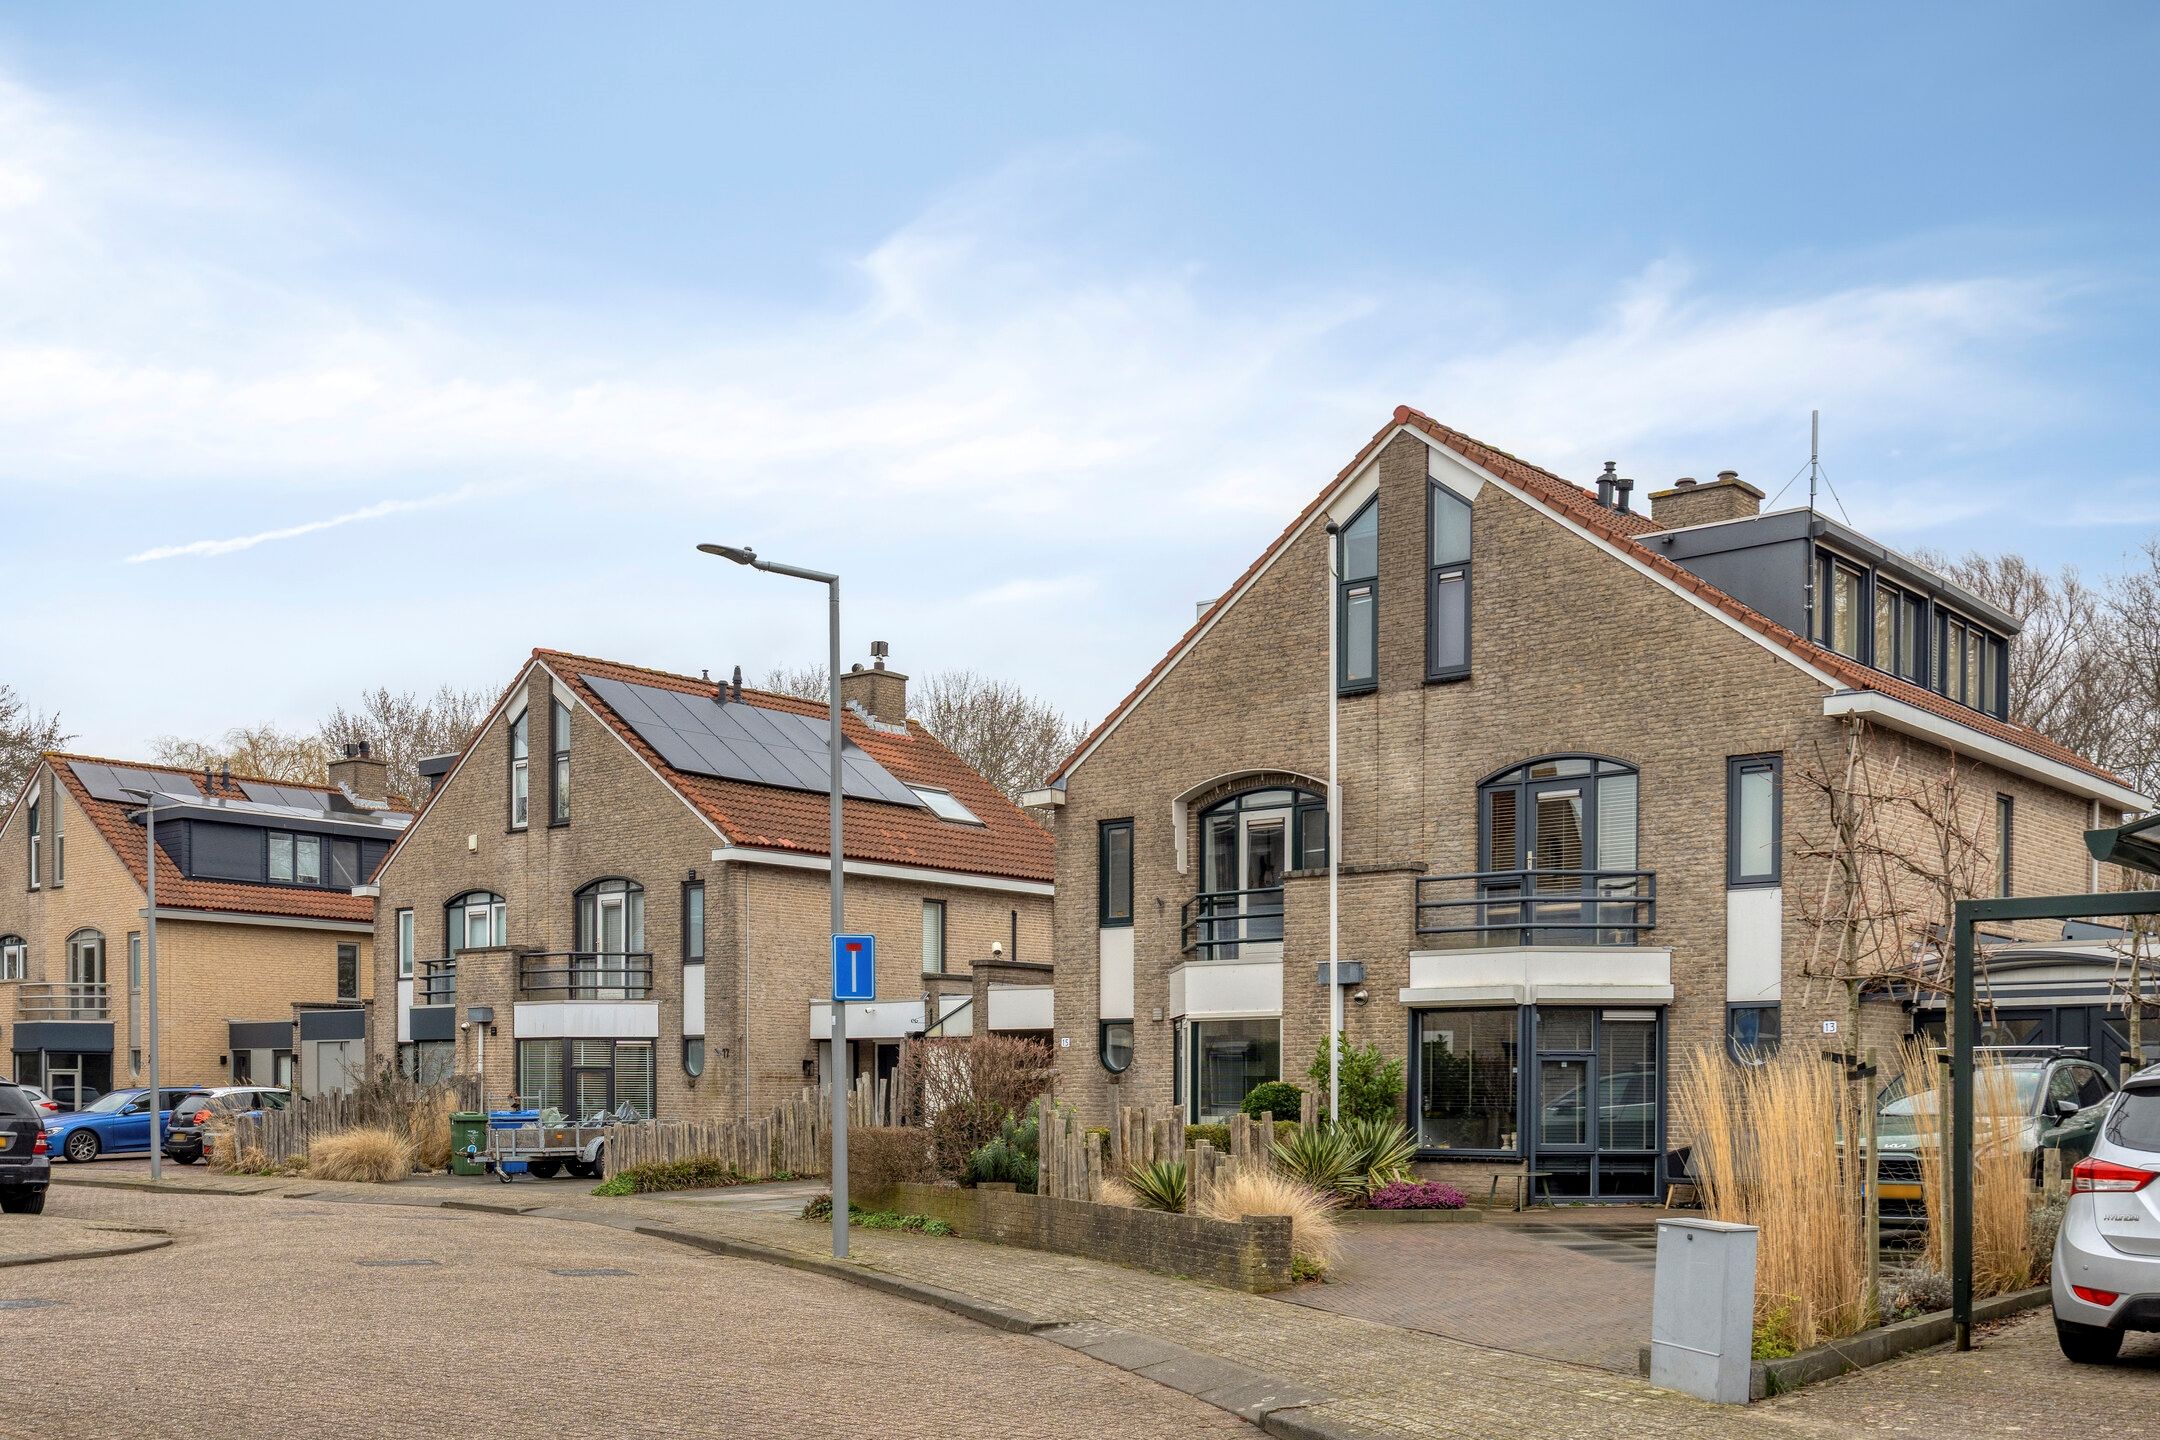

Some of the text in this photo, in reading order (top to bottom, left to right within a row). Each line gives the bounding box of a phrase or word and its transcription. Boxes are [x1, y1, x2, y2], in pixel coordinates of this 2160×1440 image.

[1825, 1022, 1835, 1031] 13
[722, 1048, 730, 1059] 17
[2103, 1213, 2140, 1222] HYUNDAI
